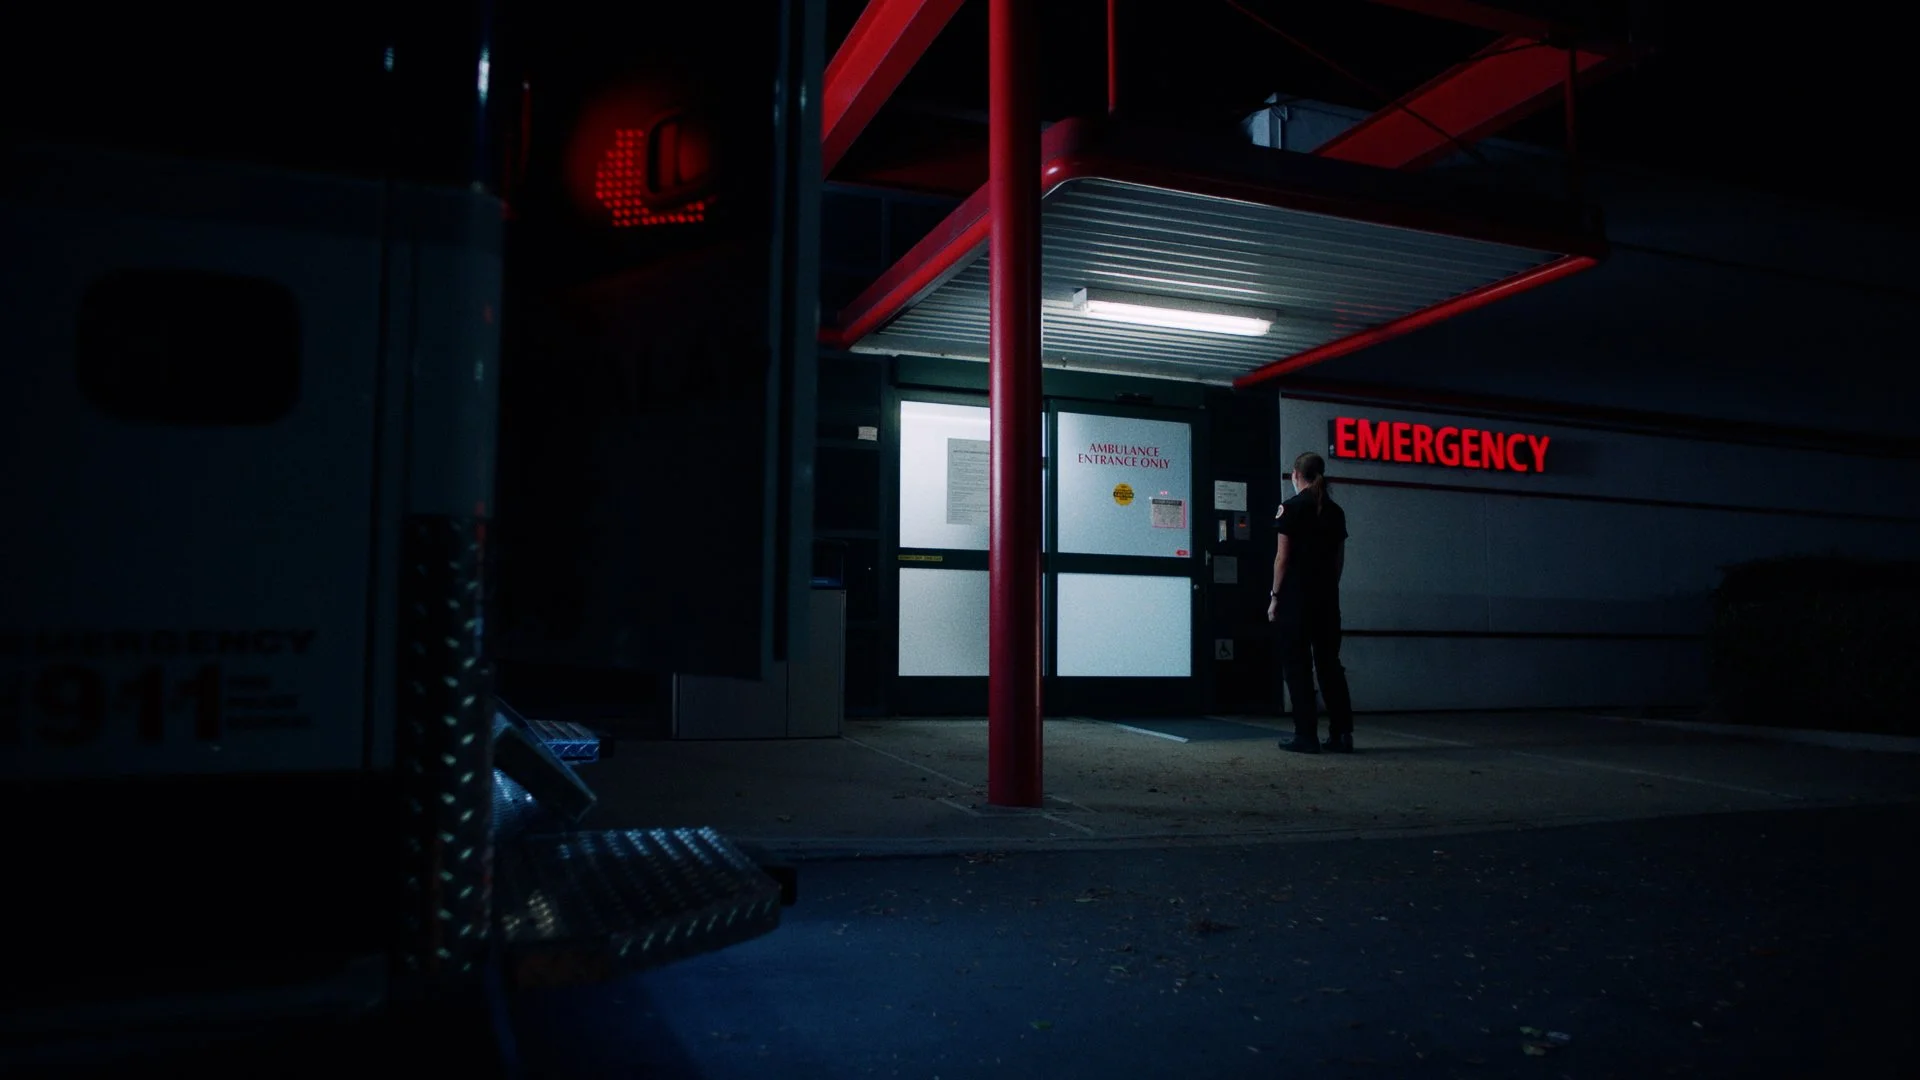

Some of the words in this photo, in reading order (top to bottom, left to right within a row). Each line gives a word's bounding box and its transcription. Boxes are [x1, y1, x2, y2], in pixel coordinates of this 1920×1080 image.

[1078, 453, 1137, 467] ENTRANCE
[1140, 458, 1171, 469] ONLY
[1089, 443, 1160, 458] AMBULANCE
[1335, 416, 1550, 473] EMERGENCY
[33, 663, 221, 743] 911
